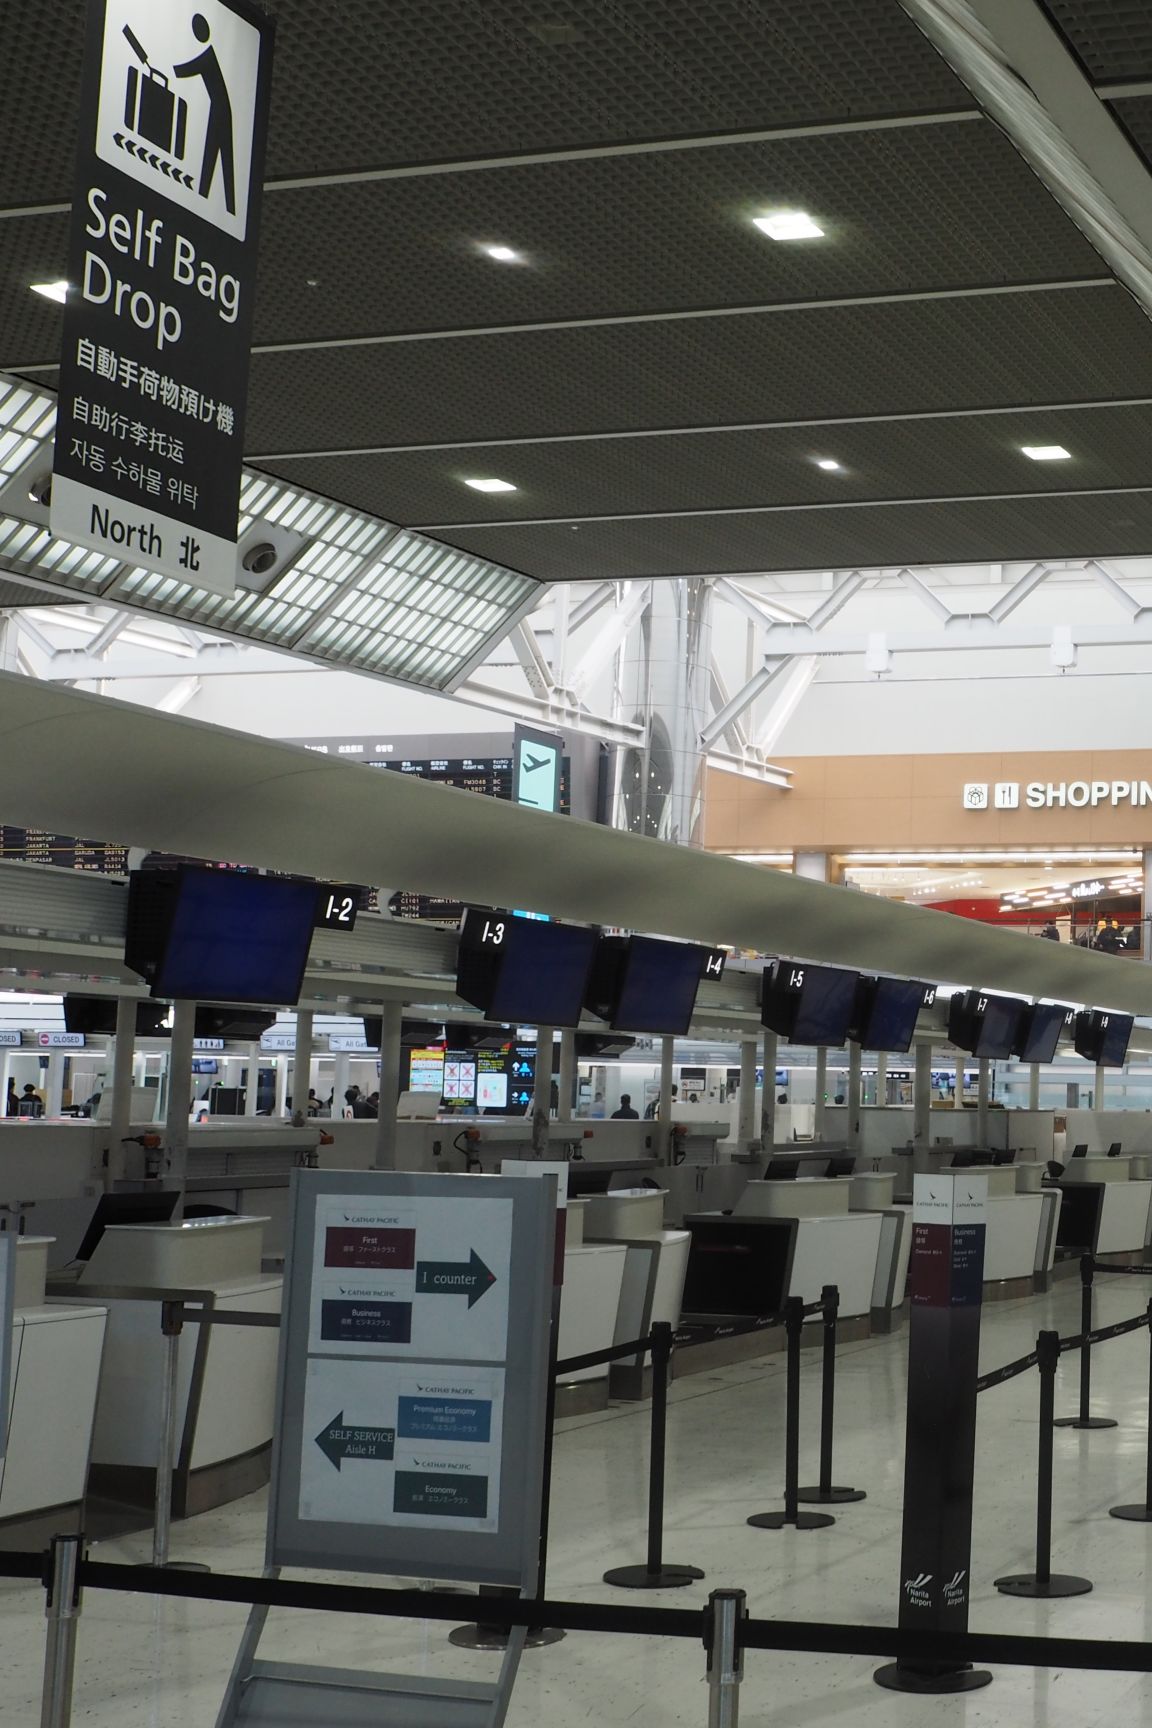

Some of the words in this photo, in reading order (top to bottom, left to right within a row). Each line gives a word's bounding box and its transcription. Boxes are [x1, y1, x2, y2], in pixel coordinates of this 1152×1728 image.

[85, 187, 163, 268] Self
[173, 234, 240, 324] Bag
[82, 250, 182, 350] Drop
[76, 337, 235, 436] 自動手荷物預け機
[72, 396, 184, 465] 自助行李托运
[70, 437, 106, 473] 자동
[111, 456, 163, 496] 수하물
[167, 476, 199, 511] 위탁
[90, 503, 163, 558] North
[178, 535, 201, 572] 北
[325, 895, 353, 922] I-2
[481, 921, 505, 945] I-3
[706, 955, 723, 975] I-4
[789, 969, 805, 988] I-5
[923, 989, 936, 1005] I-6
[53, 1036, 80, 1044] CLOSED
[915, 1227, 929, 1235] First
[362, 1236, 378, 1244] First
[423, 1272, 428, 1284] I
[434, 1273, 477, 1285] counter
[351, 1308, 382, 1318] Business
[413, 1404, 444, 1413] Premium
[444, 1406, 477, 1417] Economy
[329, 1429, 352, 1441] SELF
[354, 1431, 394, 1443] SERVICE
[345, 1444, 367, 1455] Aisle
[368, 1445, 376, 1456] H
[425, 1484, 457, 1495] Economy
[910, 1588, 930, 1599] Narita
[910, 1596, 932, 1607] Airport
